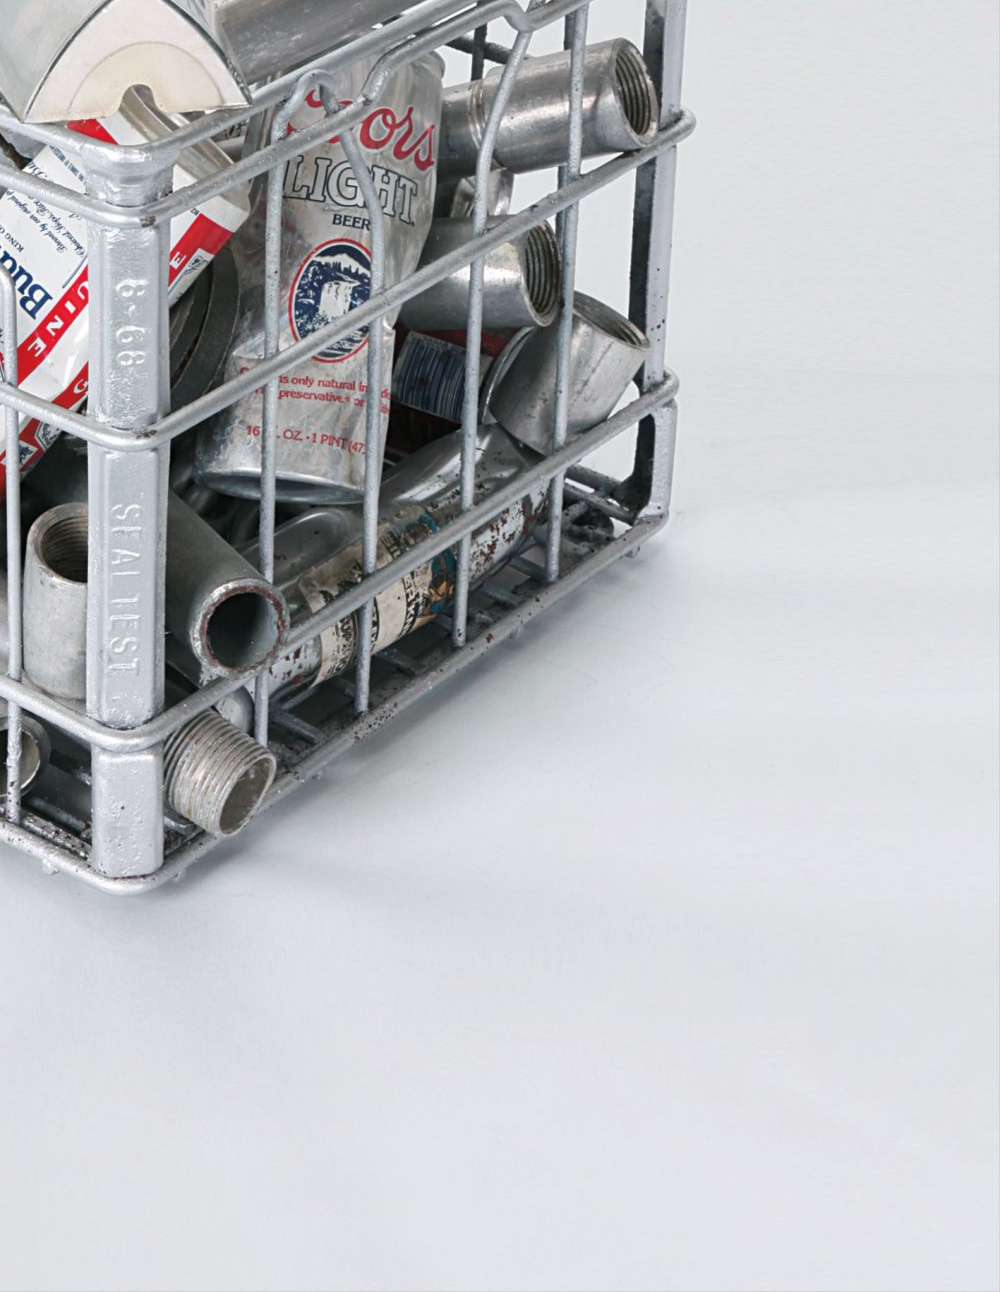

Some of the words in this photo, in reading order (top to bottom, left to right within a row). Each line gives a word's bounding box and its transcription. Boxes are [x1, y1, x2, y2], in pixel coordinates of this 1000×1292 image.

[332, 213, 372, 231] BEER
[5, 233, 24, 253] KING
[291, 376, 315, 388] only
[317, 379, 356, 392] natural
[247, 424, 261, 437] 16
[320, 434, 346, 450] PINT
[347, 440, 367, 455] (47
